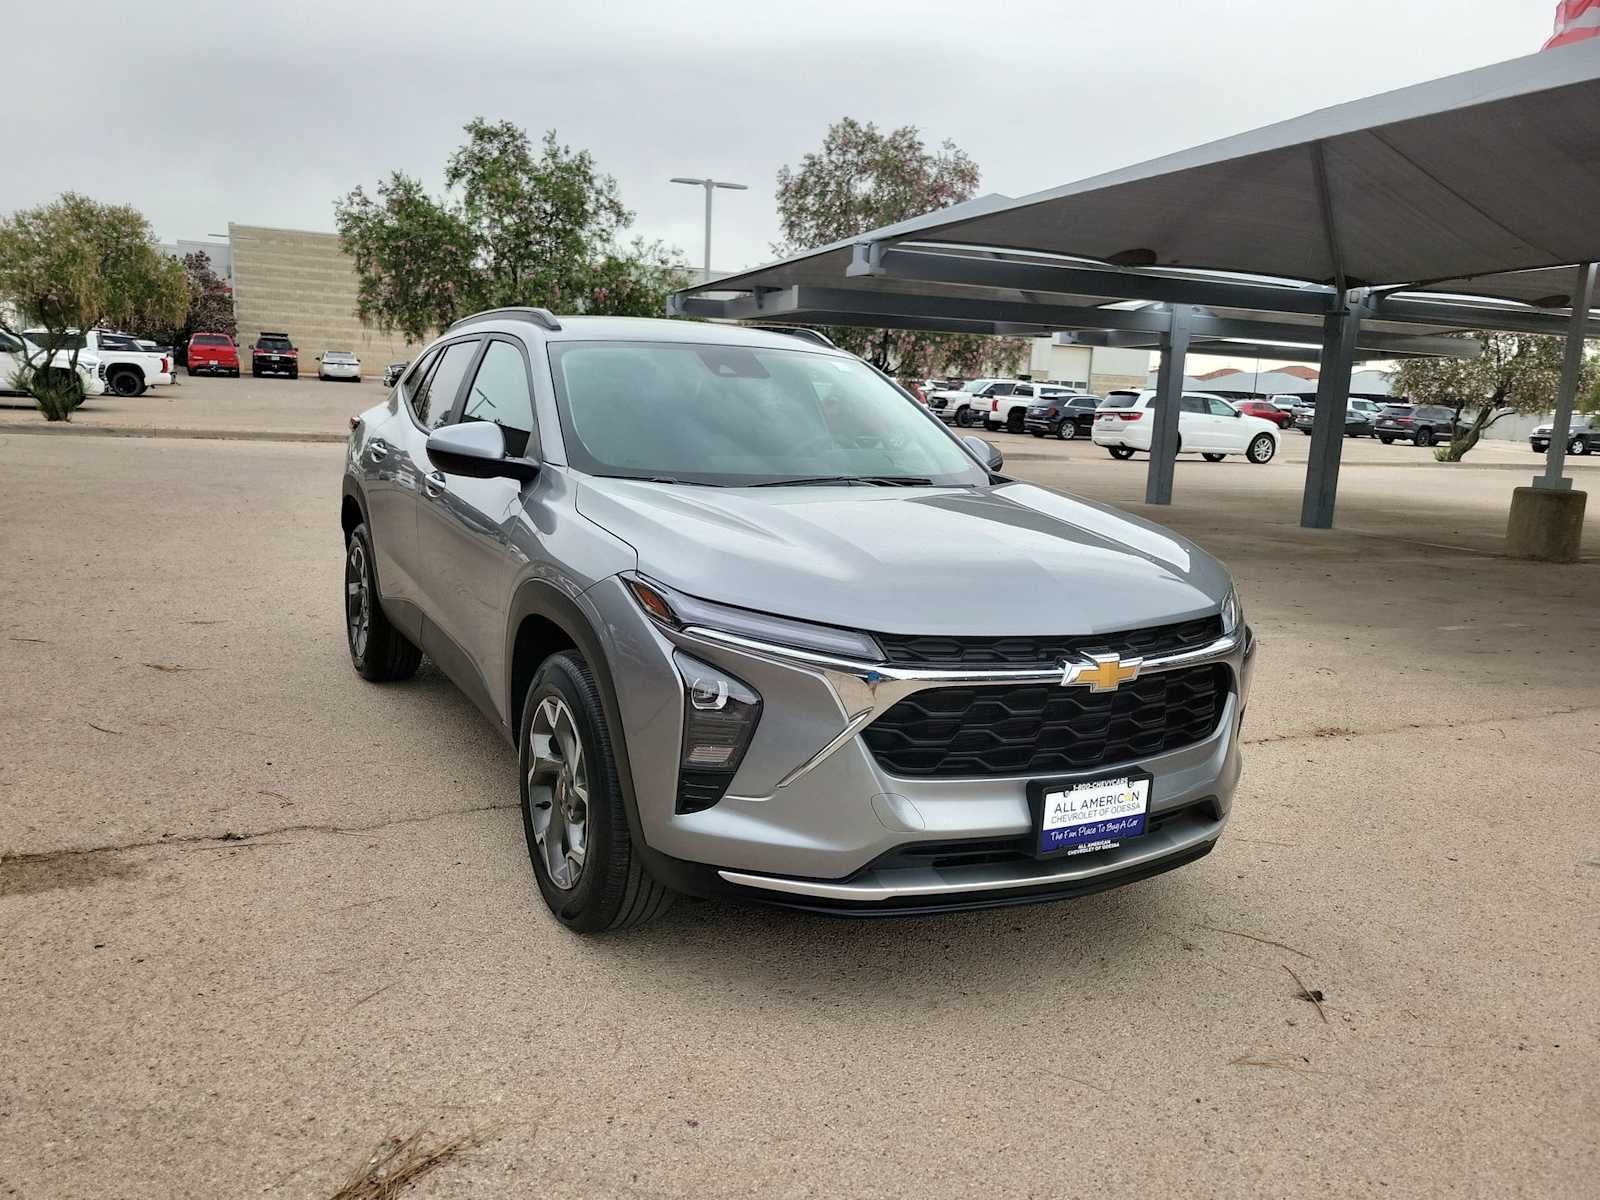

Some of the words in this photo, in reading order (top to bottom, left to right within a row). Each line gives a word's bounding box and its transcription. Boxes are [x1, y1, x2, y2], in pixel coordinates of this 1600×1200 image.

[1051, 809, 1097, 824] CHEVROLET
[1100, 806, 1110, 817] OF
[1111, 802, 1141, 814] ODESSA
[1054, 802, 1076, 814] ALL
[1050, 831, 1063, 841] The
[1078, 825, 1097, 838] Place
[1098, 823, 1106, 833] To
[1105, 821, 1120, 833] Buy
[1119, 819, 1128, 830] A
[1127, 818, 1139, 828] Car
[1067, 846, 1094, 856] CHEVROLET
[1102, 841, 1120, 850] ODESSA
[1087, 839, 1112, 848] AMERICAN
